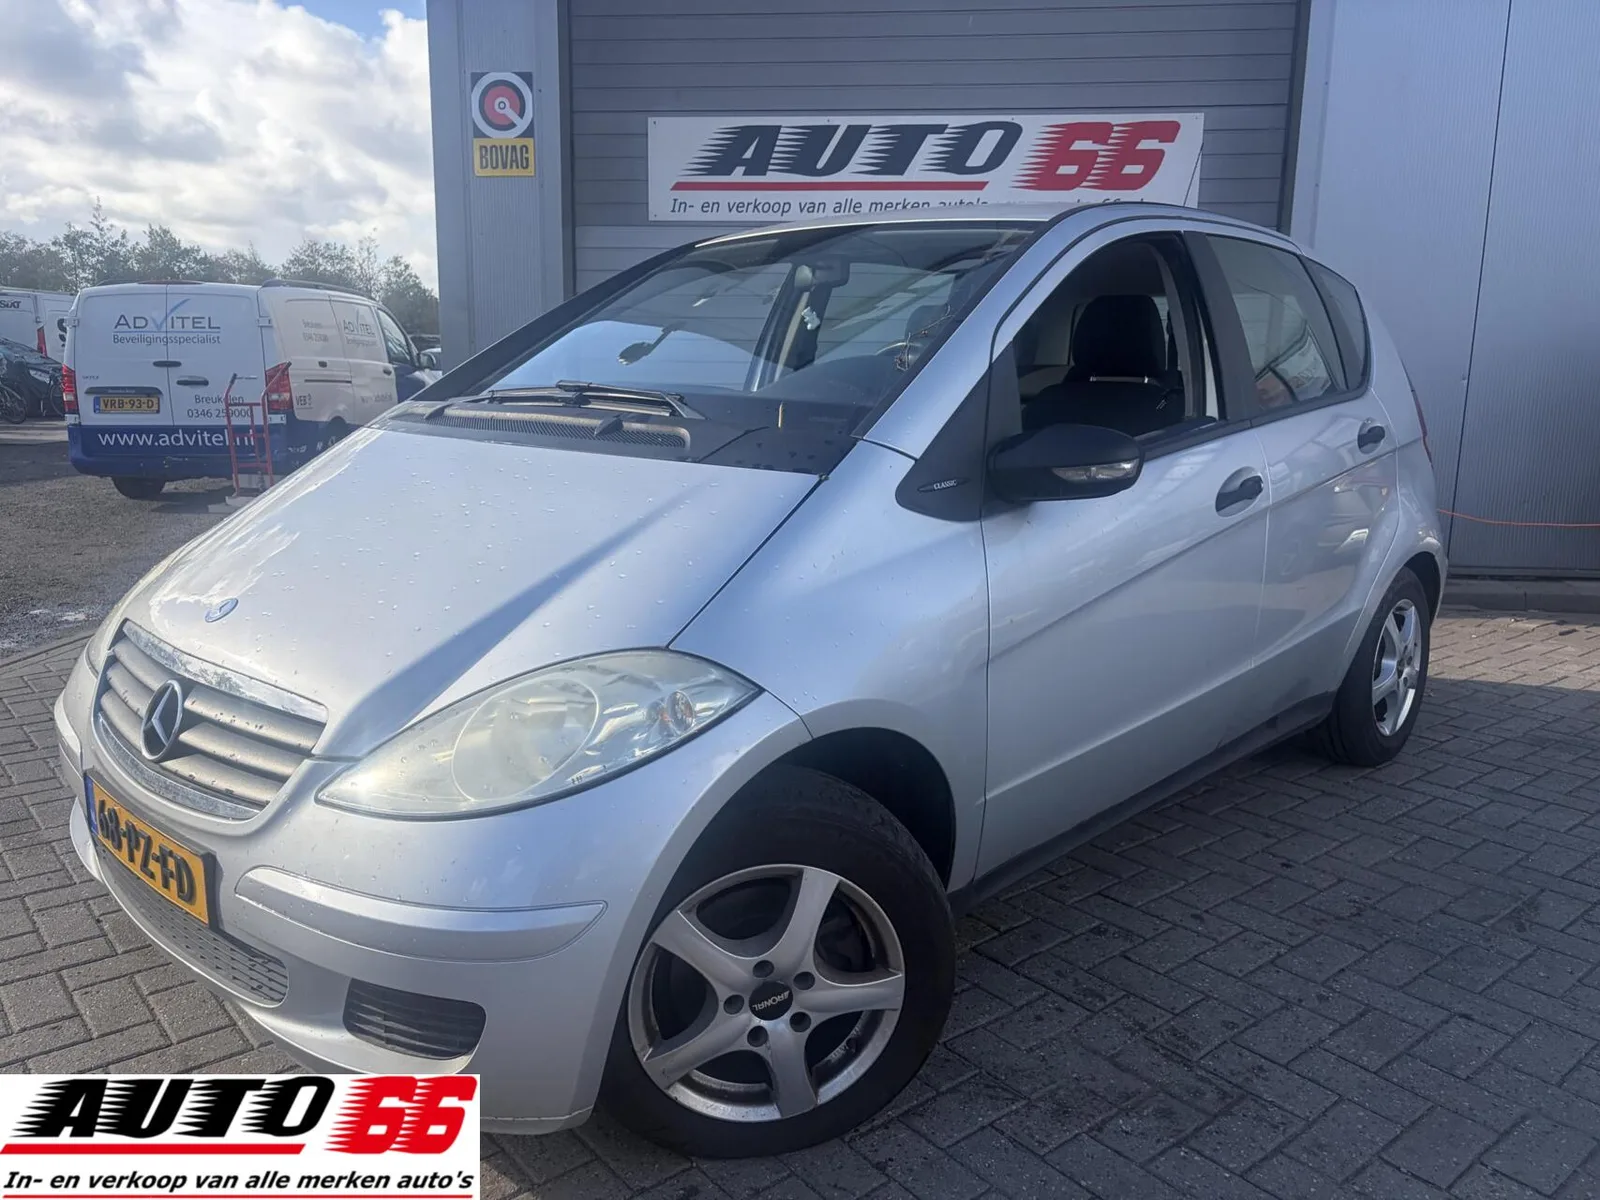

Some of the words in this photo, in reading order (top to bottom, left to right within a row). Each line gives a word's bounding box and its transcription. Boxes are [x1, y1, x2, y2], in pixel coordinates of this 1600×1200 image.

[479, 144, 529, 170] BOVAG
[679, 121, 1023, 177] AUTO
[1010, 120, 1181, 191] 66
[670, 198, 694, 213] In-
[701, 201, 720, 213] en
[727, 199, 791, 216] verkoop
[799, 201, 826, 213] van
[832, 198, 862, 214] alle
[868, 198, 931, 213] merken
[114, 305, 221, 331] ADVITEL
[113, 334, 221, 345] Beveiligingsspecialist
[102, 399, 154, 409] VRB-93-D
[194, 394, 244, 404] Breuklen
[187, 408, 212, 418] 0346
[98, 429, 255, 446] www.advitel.nl
[933, 479, 957, 490] CLASSIC
